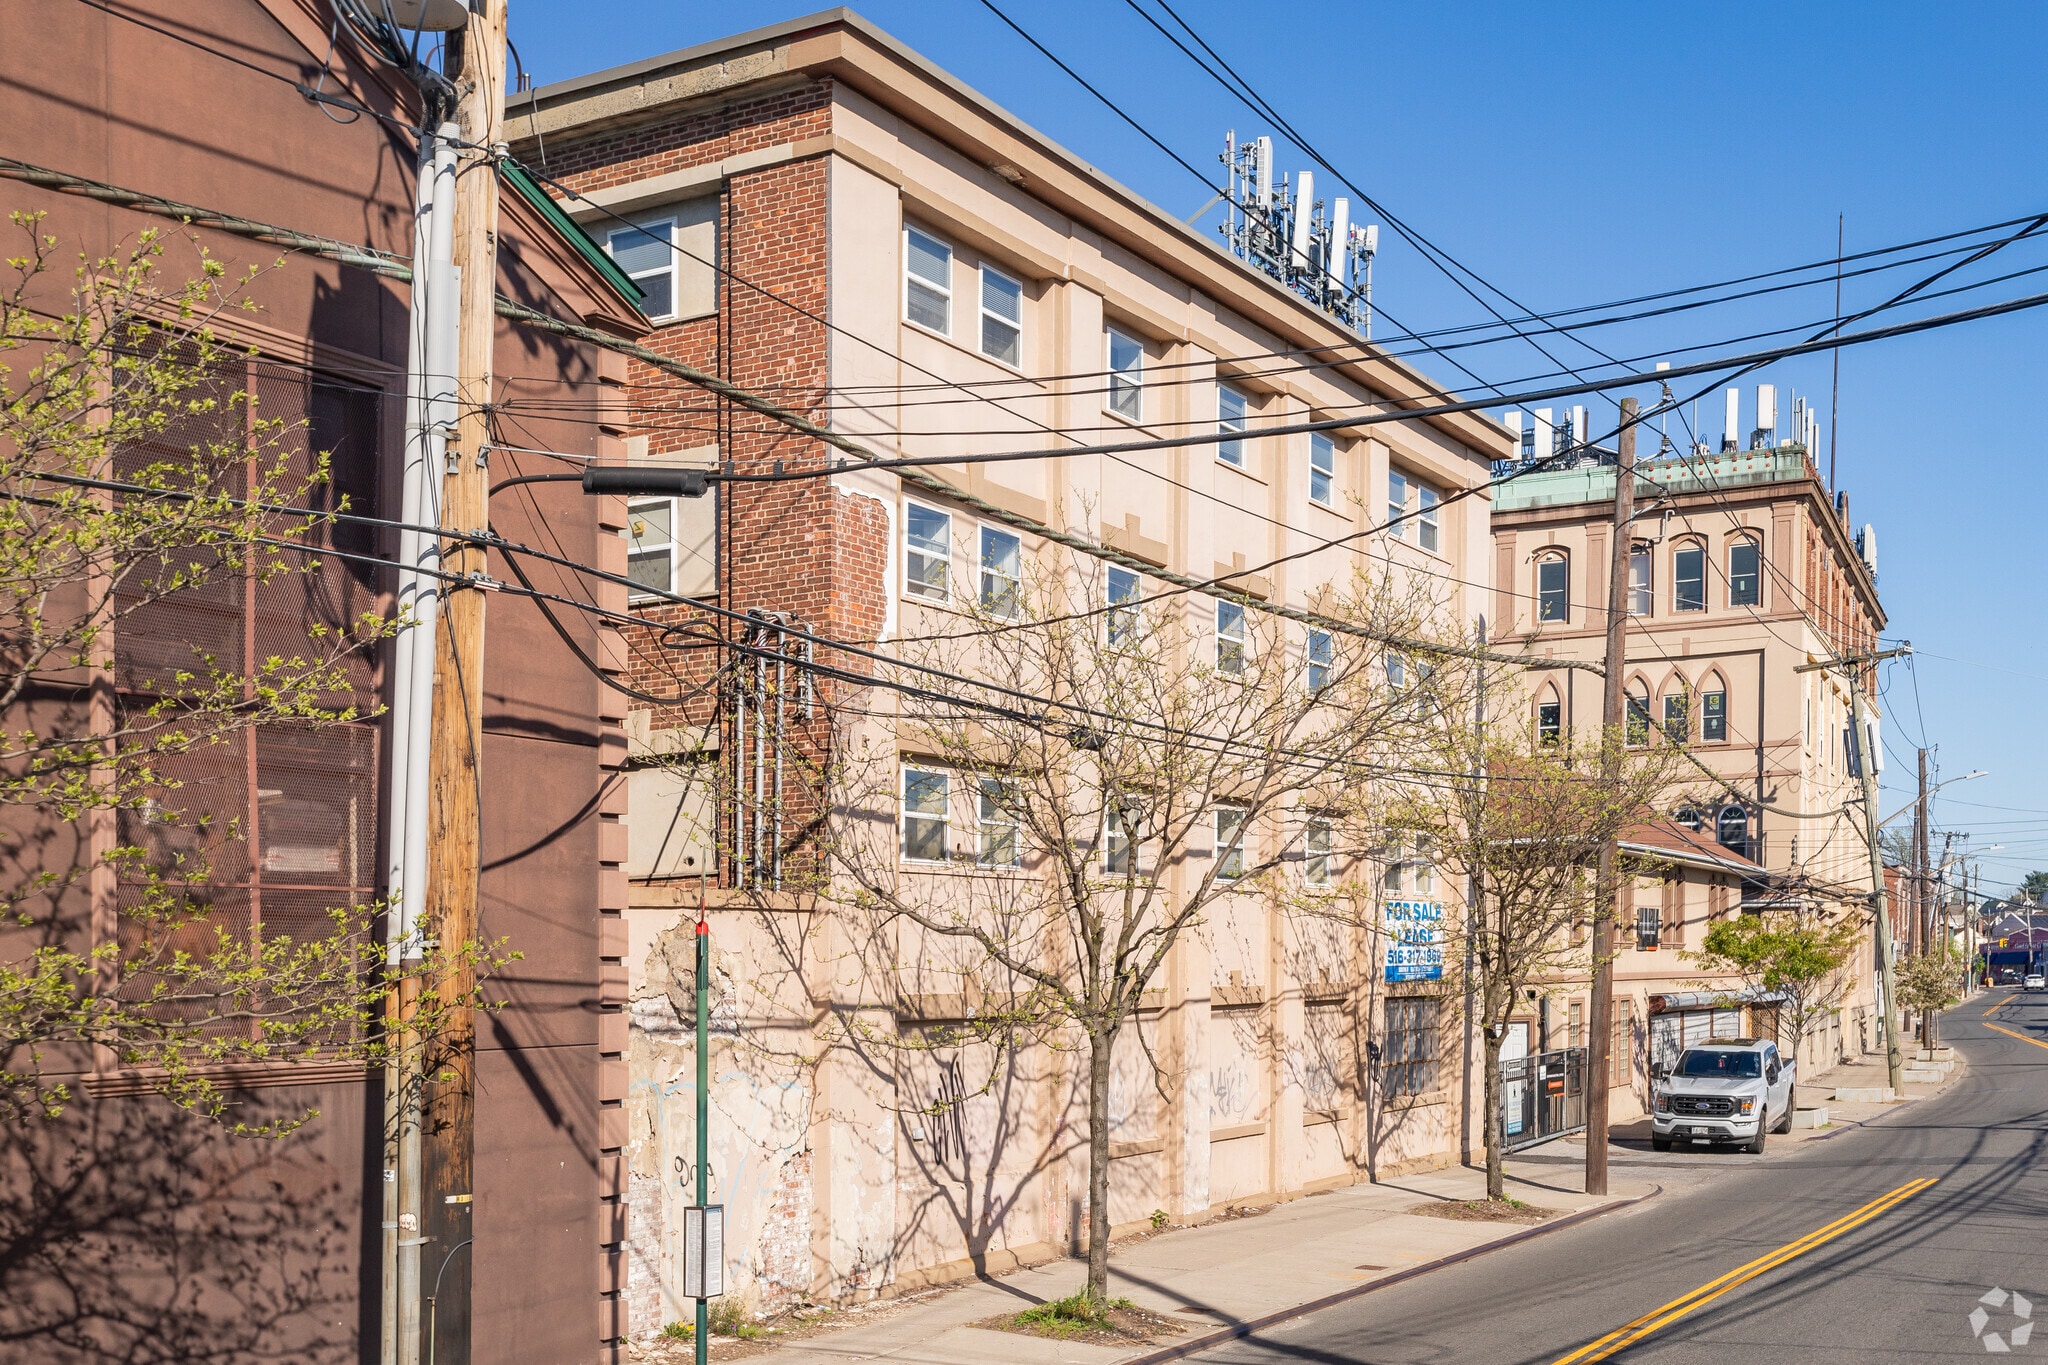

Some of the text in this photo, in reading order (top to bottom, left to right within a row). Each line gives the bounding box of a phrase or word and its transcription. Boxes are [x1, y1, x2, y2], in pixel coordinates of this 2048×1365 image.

[1387, 902, 1441, 921] FOR SALE
[1398, 928, 1434, 947] LEASE
